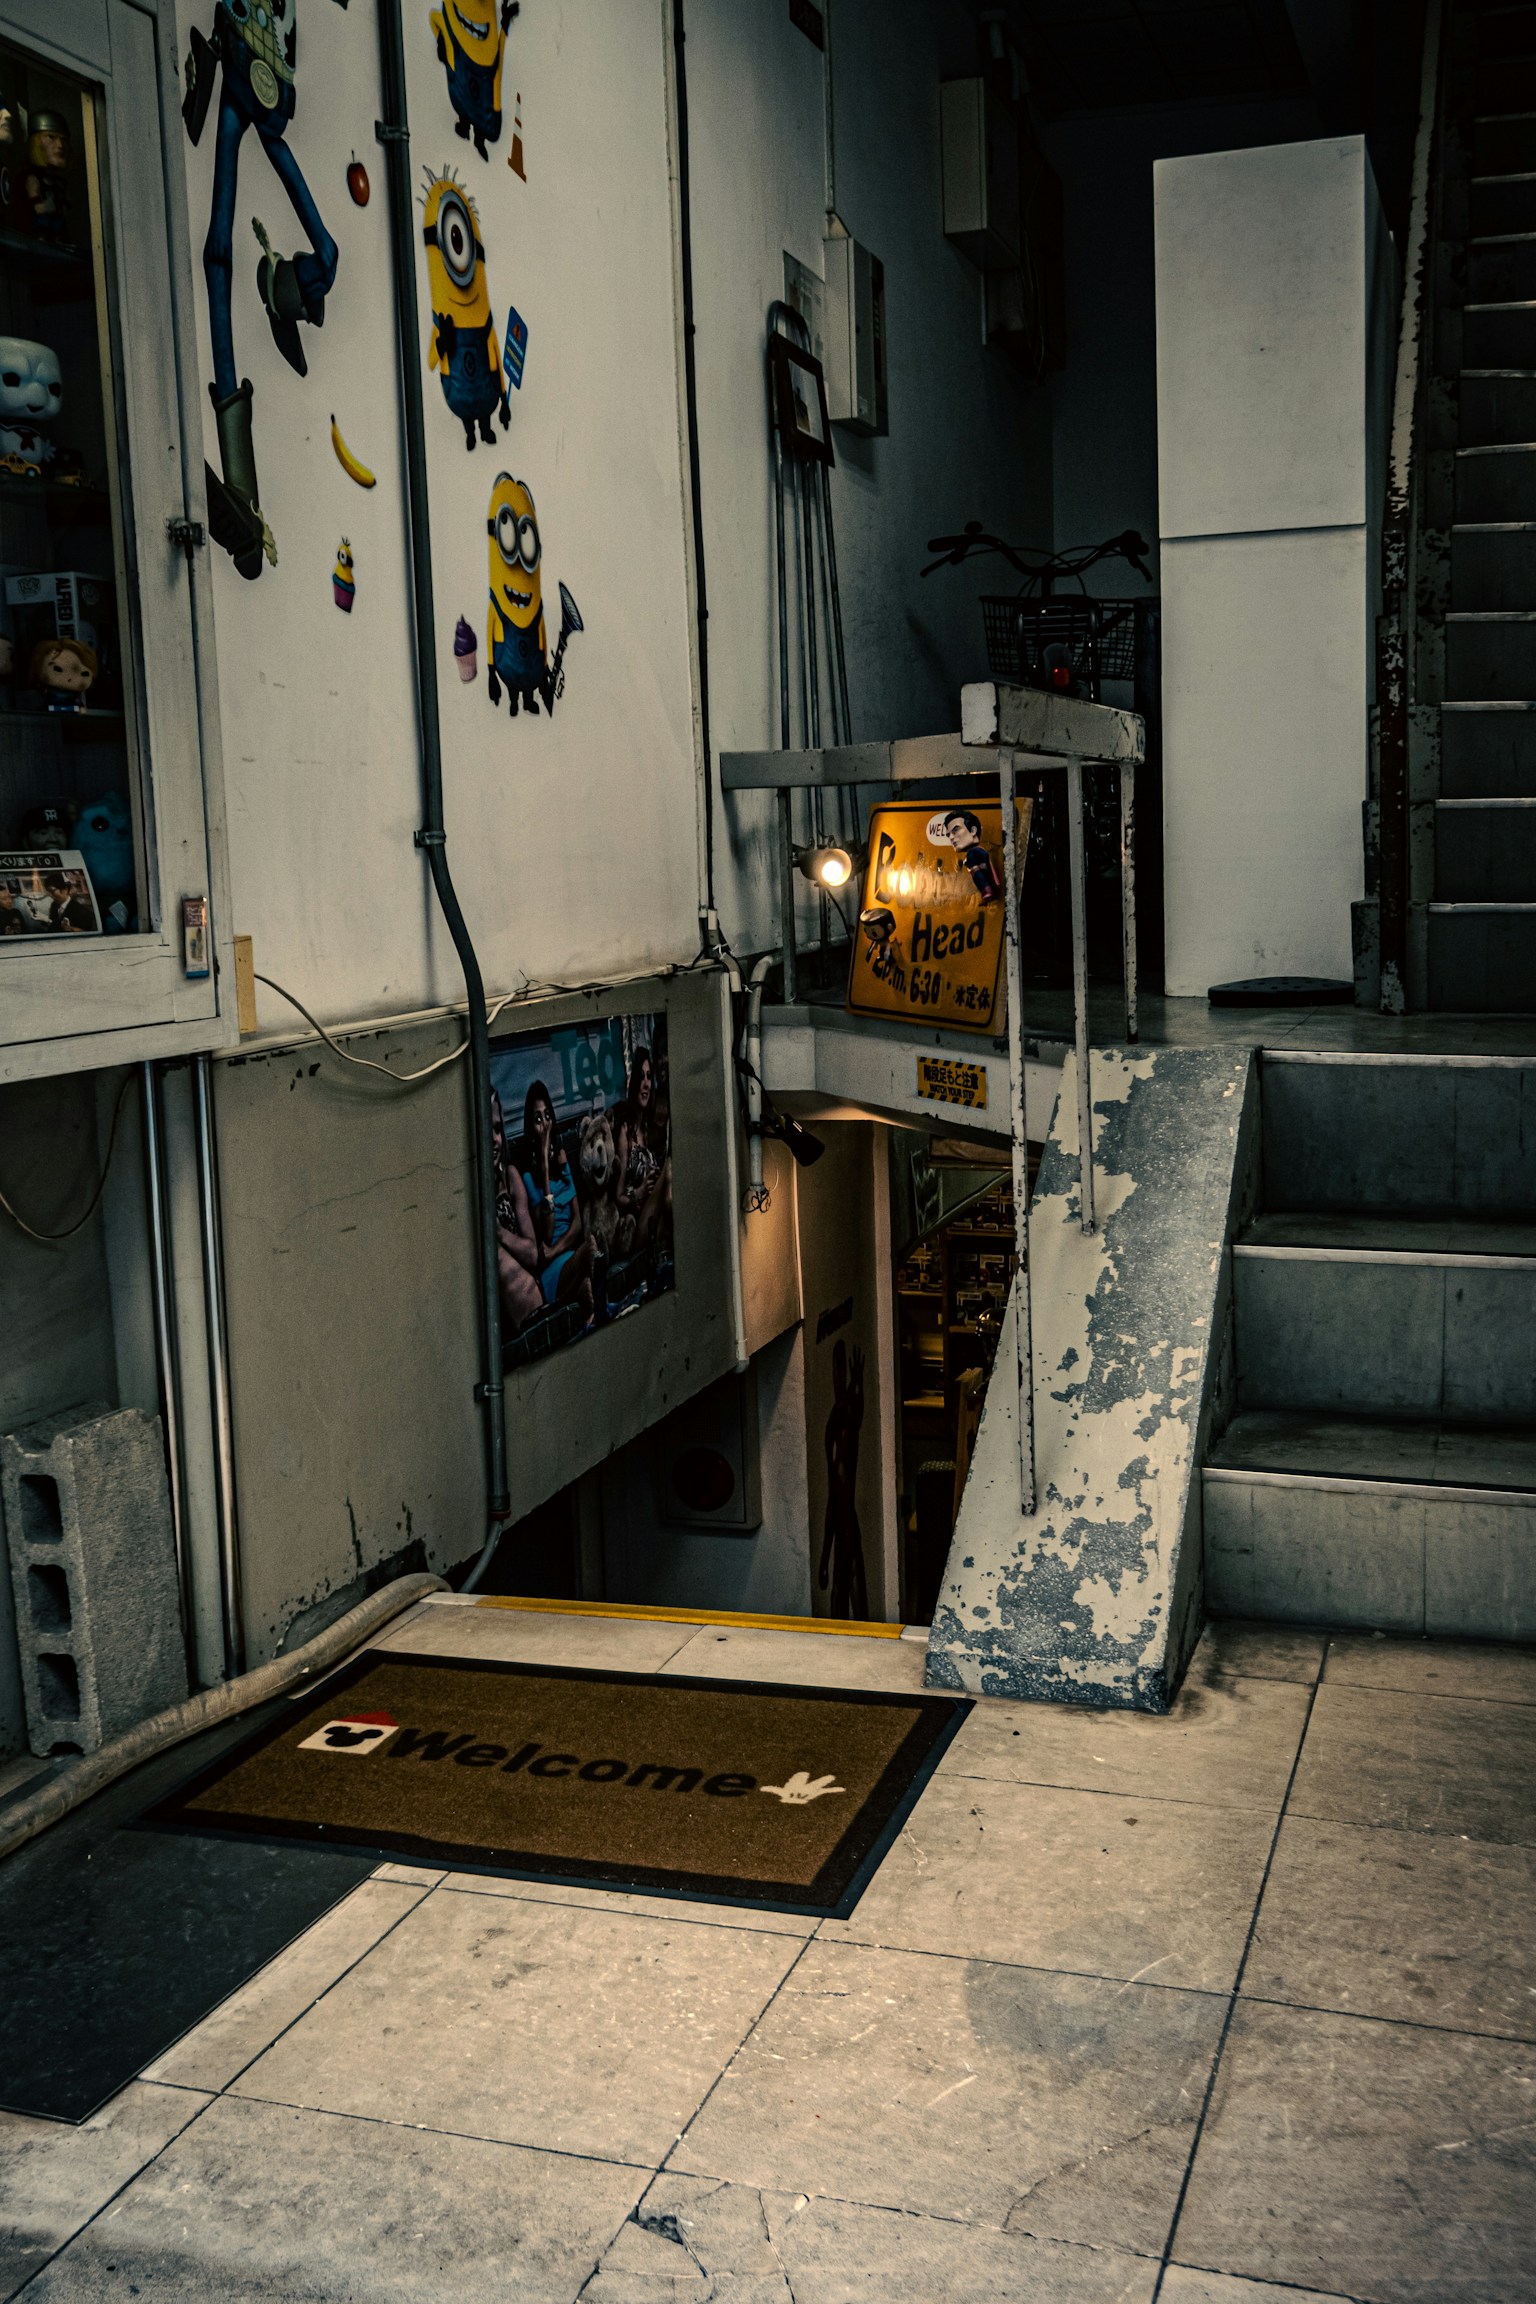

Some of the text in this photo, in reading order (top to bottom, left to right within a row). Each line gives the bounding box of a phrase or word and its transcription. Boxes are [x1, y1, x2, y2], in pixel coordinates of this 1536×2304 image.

[56, 578, 73, 620] ALFRED
[911, 910, 985, 963] Head
[910, 966, 941, 1005] 6:30
[551, 1015, 625, 1105] Ted
[929, 1083, 975, 1100] WATCH YOUR STEP
[387, 1728, 757, 1797] Welcome
